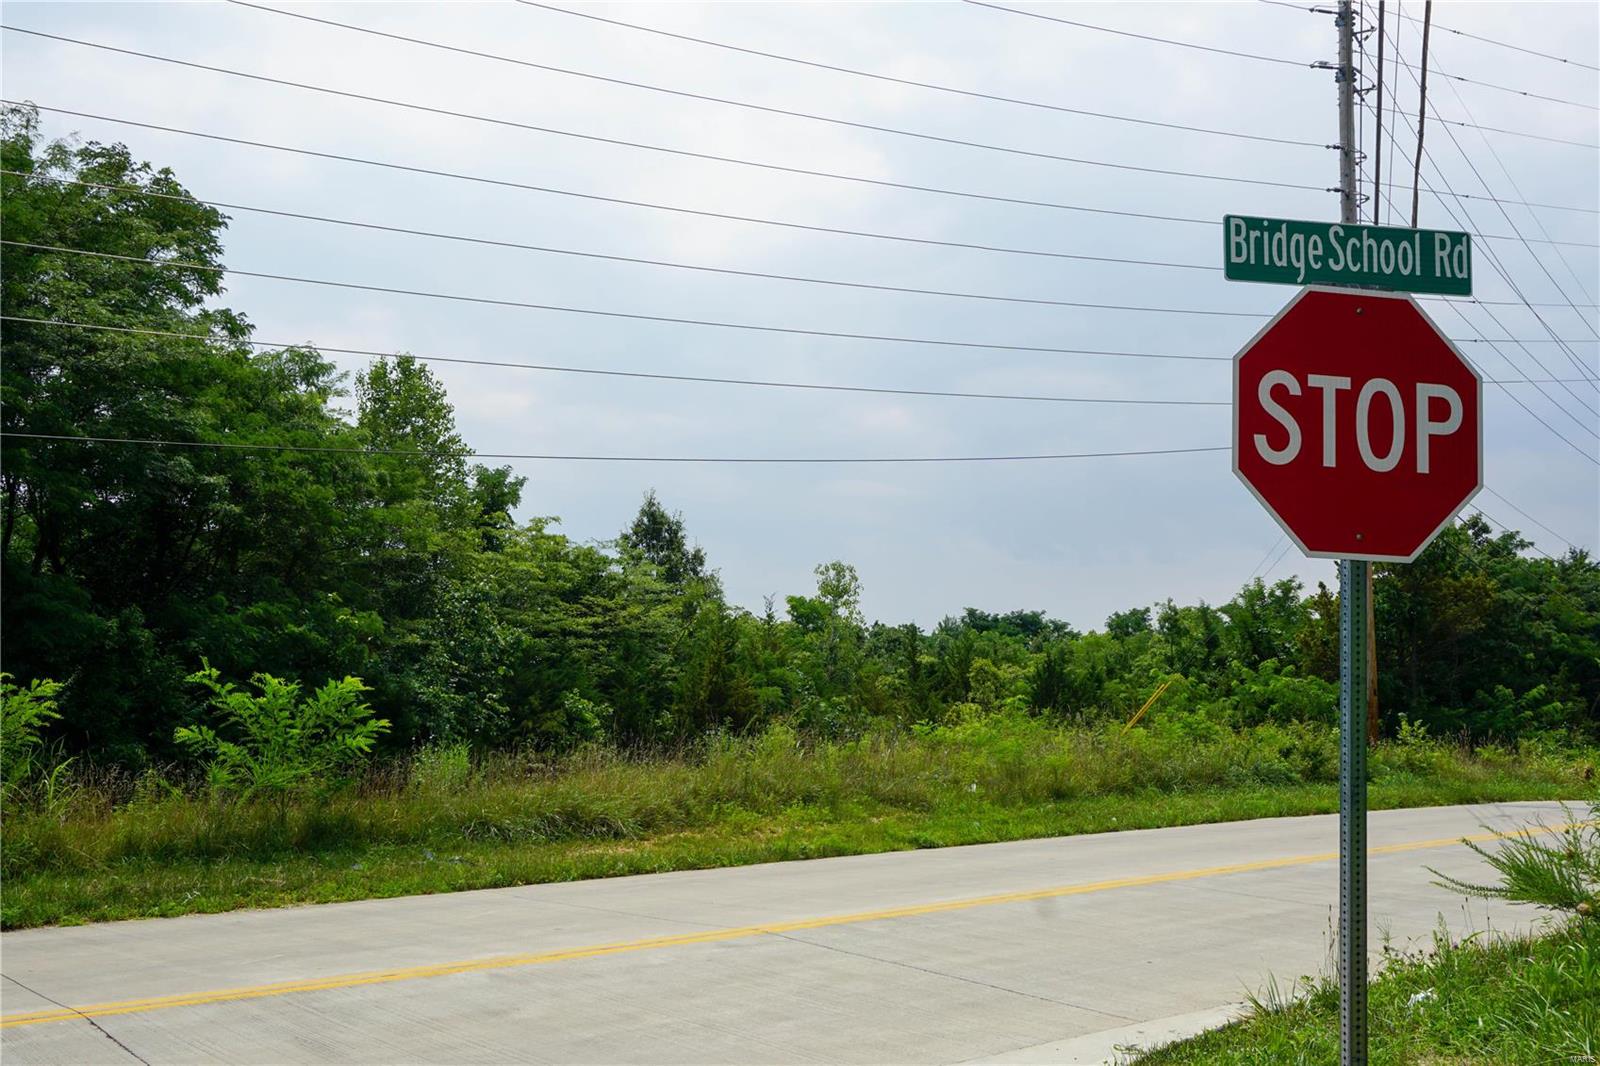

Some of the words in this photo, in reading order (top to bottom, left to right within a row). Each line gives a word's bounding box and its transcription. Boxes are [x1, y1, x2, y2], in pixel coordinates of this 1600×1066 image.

[1230, 217, 1323, 283] Bridge
[1328, 225, 1421, 276] School
[1434, 232, 1468, 279] Rd
[1253, 369, 1464, 474] STOP
